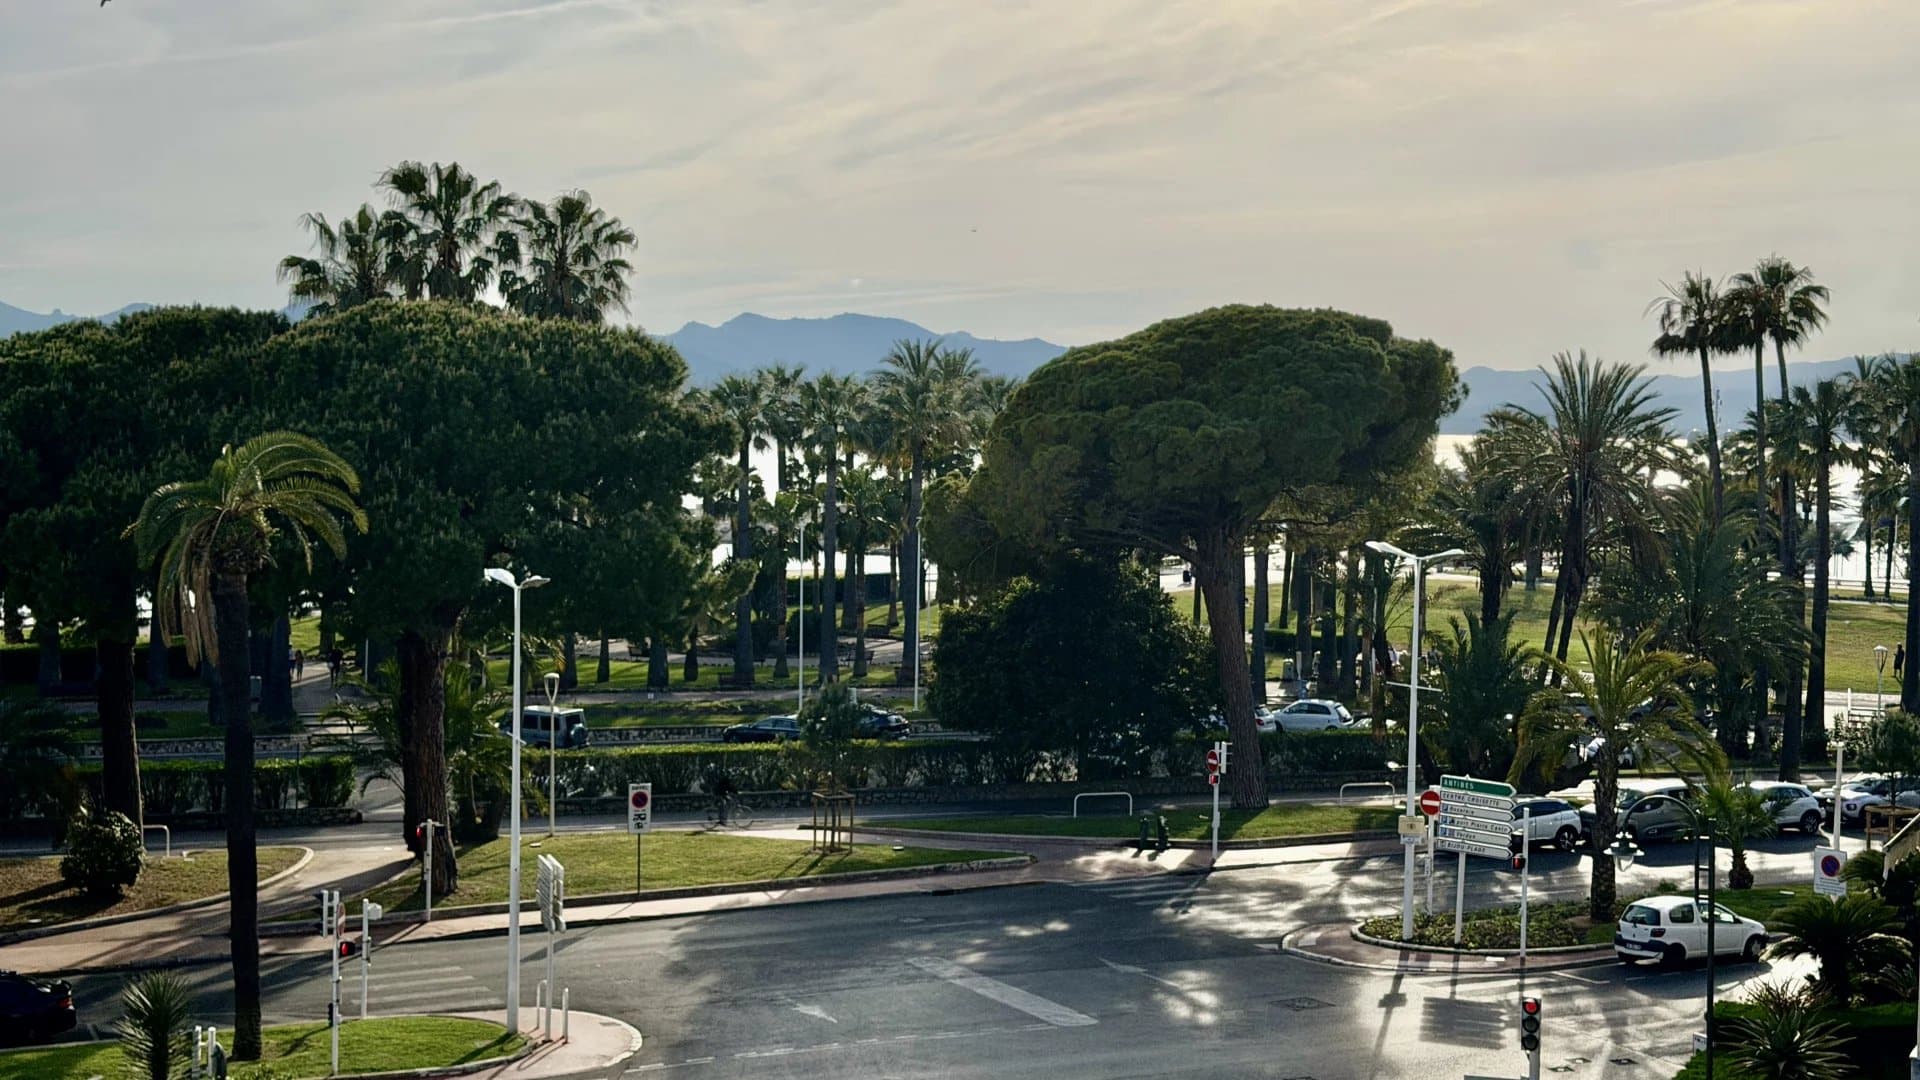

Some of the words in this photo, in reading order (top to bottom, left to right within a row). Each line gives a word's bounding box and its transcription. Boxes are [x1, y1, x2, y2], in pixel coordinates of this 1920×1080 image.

[1443, 779, 1474, 790] ANTIBES
[1443, 792, 1465, 801] CENTRE
[1467, 796, 1499, 806] CROISETTE
